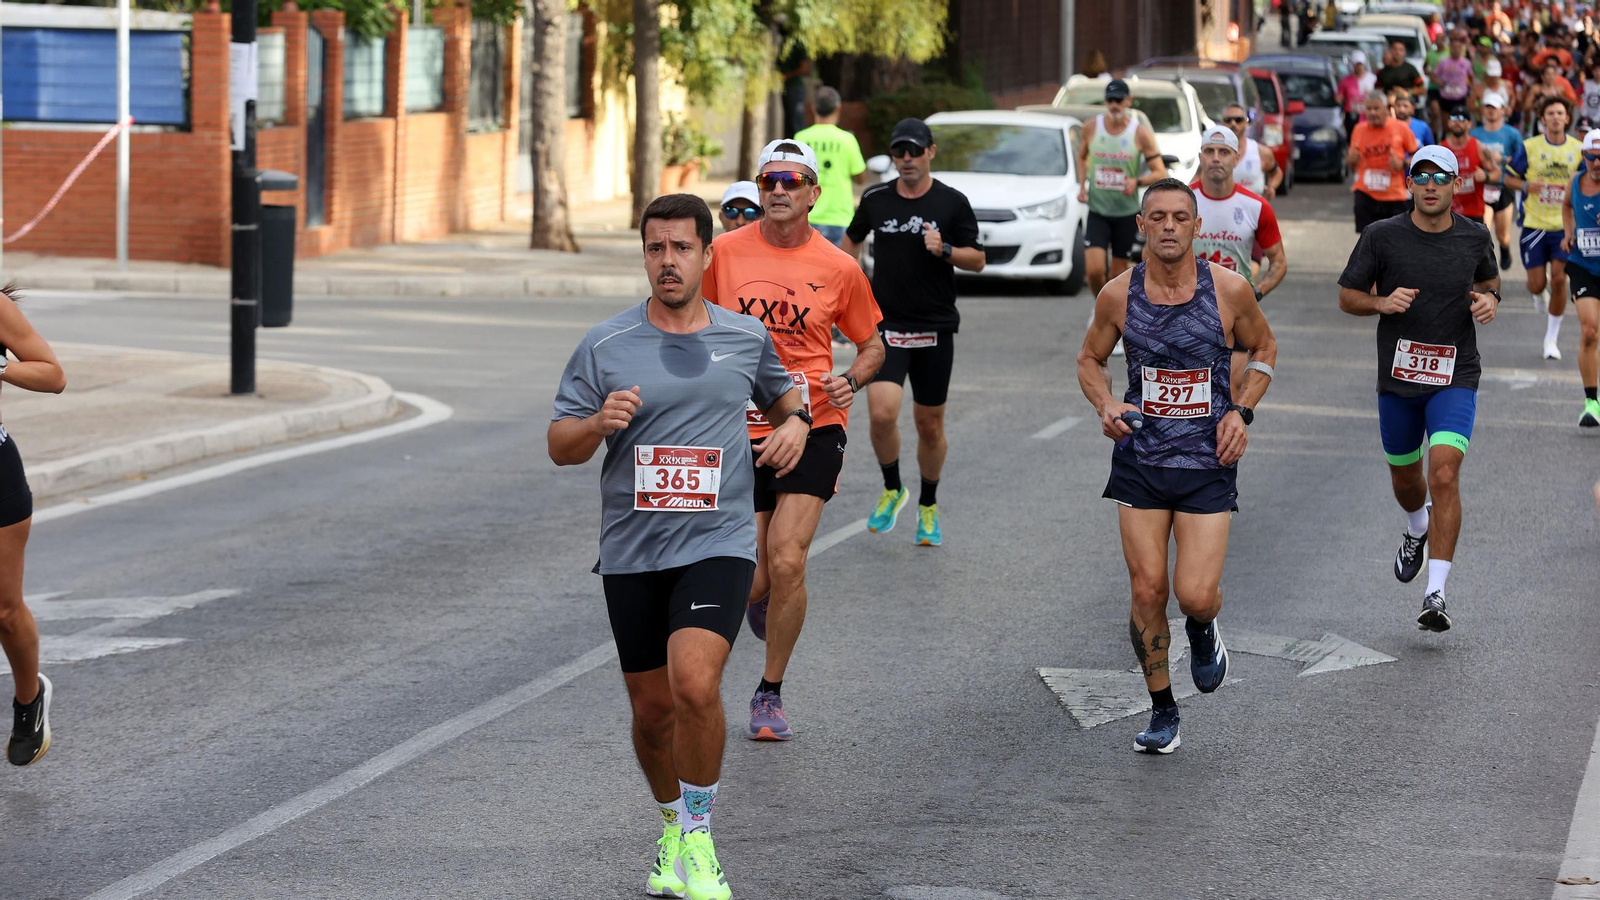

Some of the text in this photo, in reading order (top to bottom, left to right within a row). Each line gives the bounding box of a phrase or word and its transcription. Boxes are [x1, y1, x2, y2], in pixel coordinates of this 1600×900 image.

[806, 141, 841, 152] TAFF
[1408, 355, 1440, 371] 318
[1158, 385, 1194, 403] 297
[656, 468, 700, 490] 365
